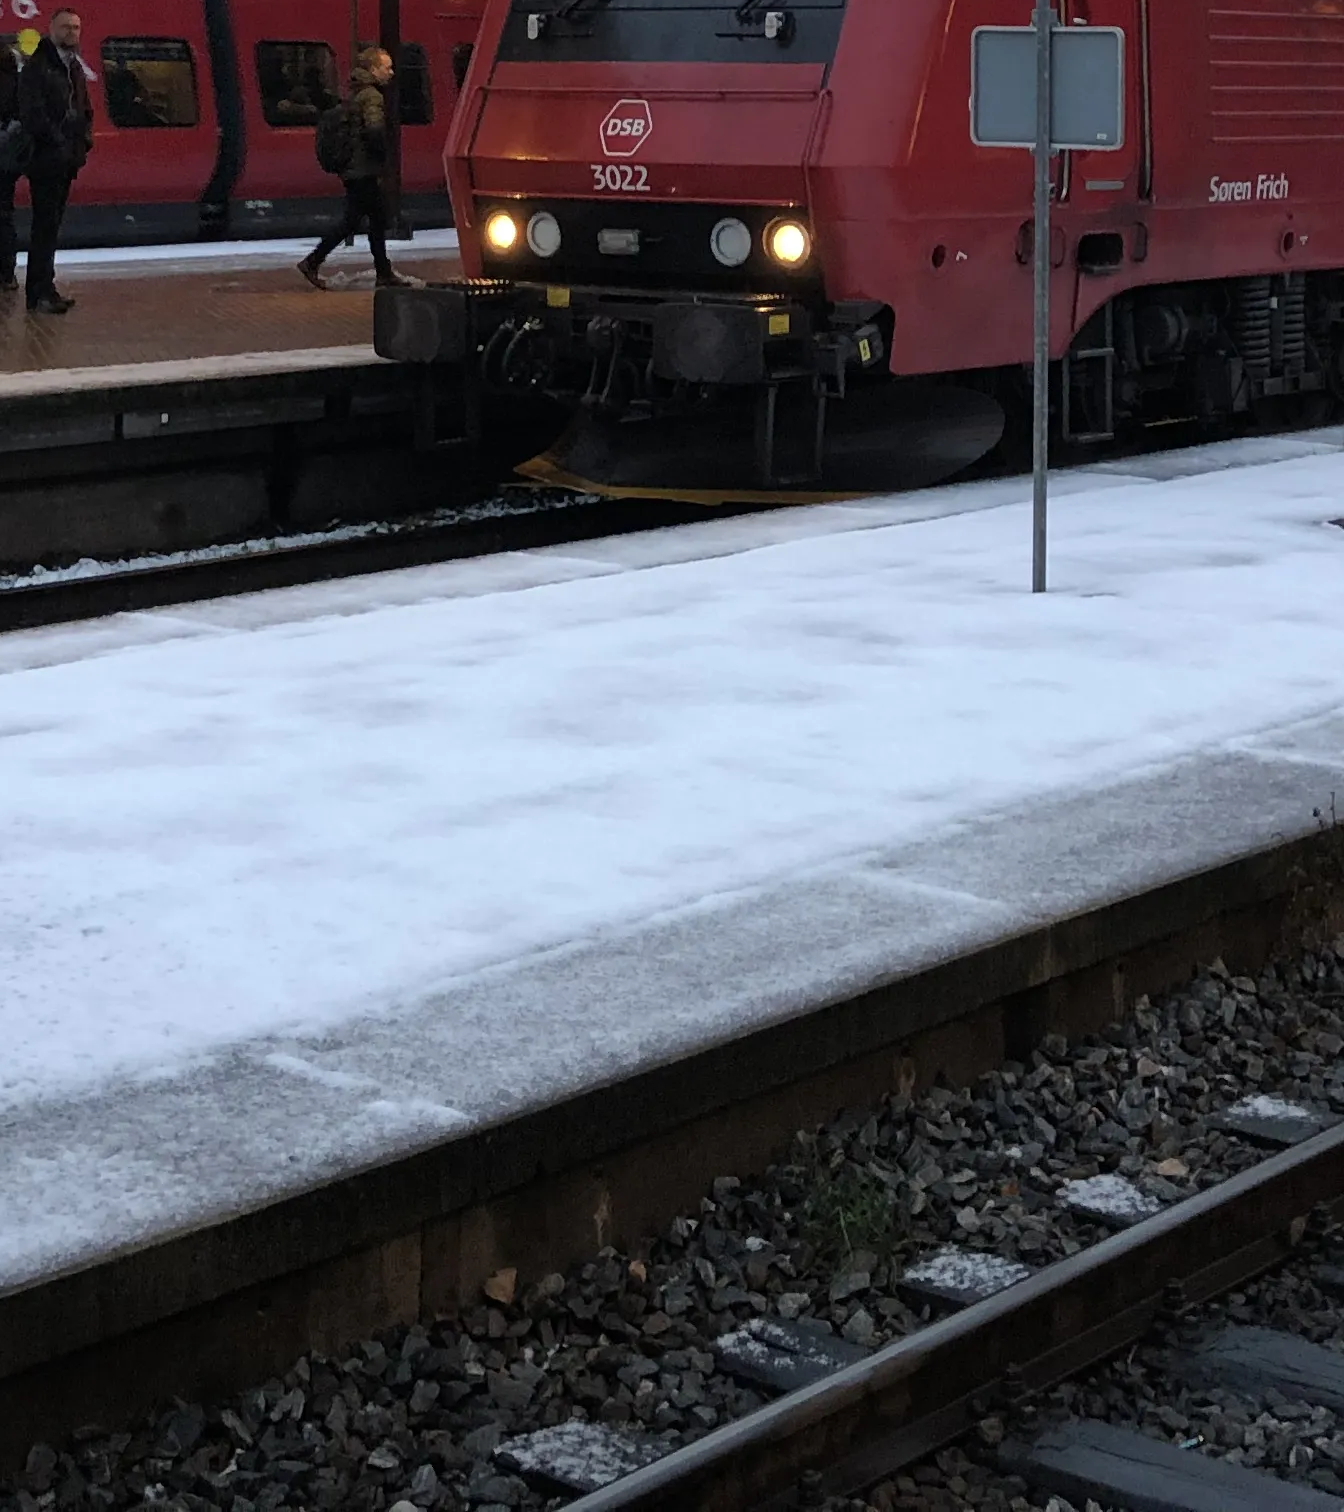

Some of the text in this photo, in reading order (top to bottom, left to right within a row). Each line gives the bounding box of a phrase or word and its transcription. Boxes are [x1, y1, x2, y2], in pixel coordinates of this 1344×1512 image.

[606, 118, 645, 136] DSB
[590, 164, 651, 191] 3022
[1208, 172, 1289, 202] Søren Frich
